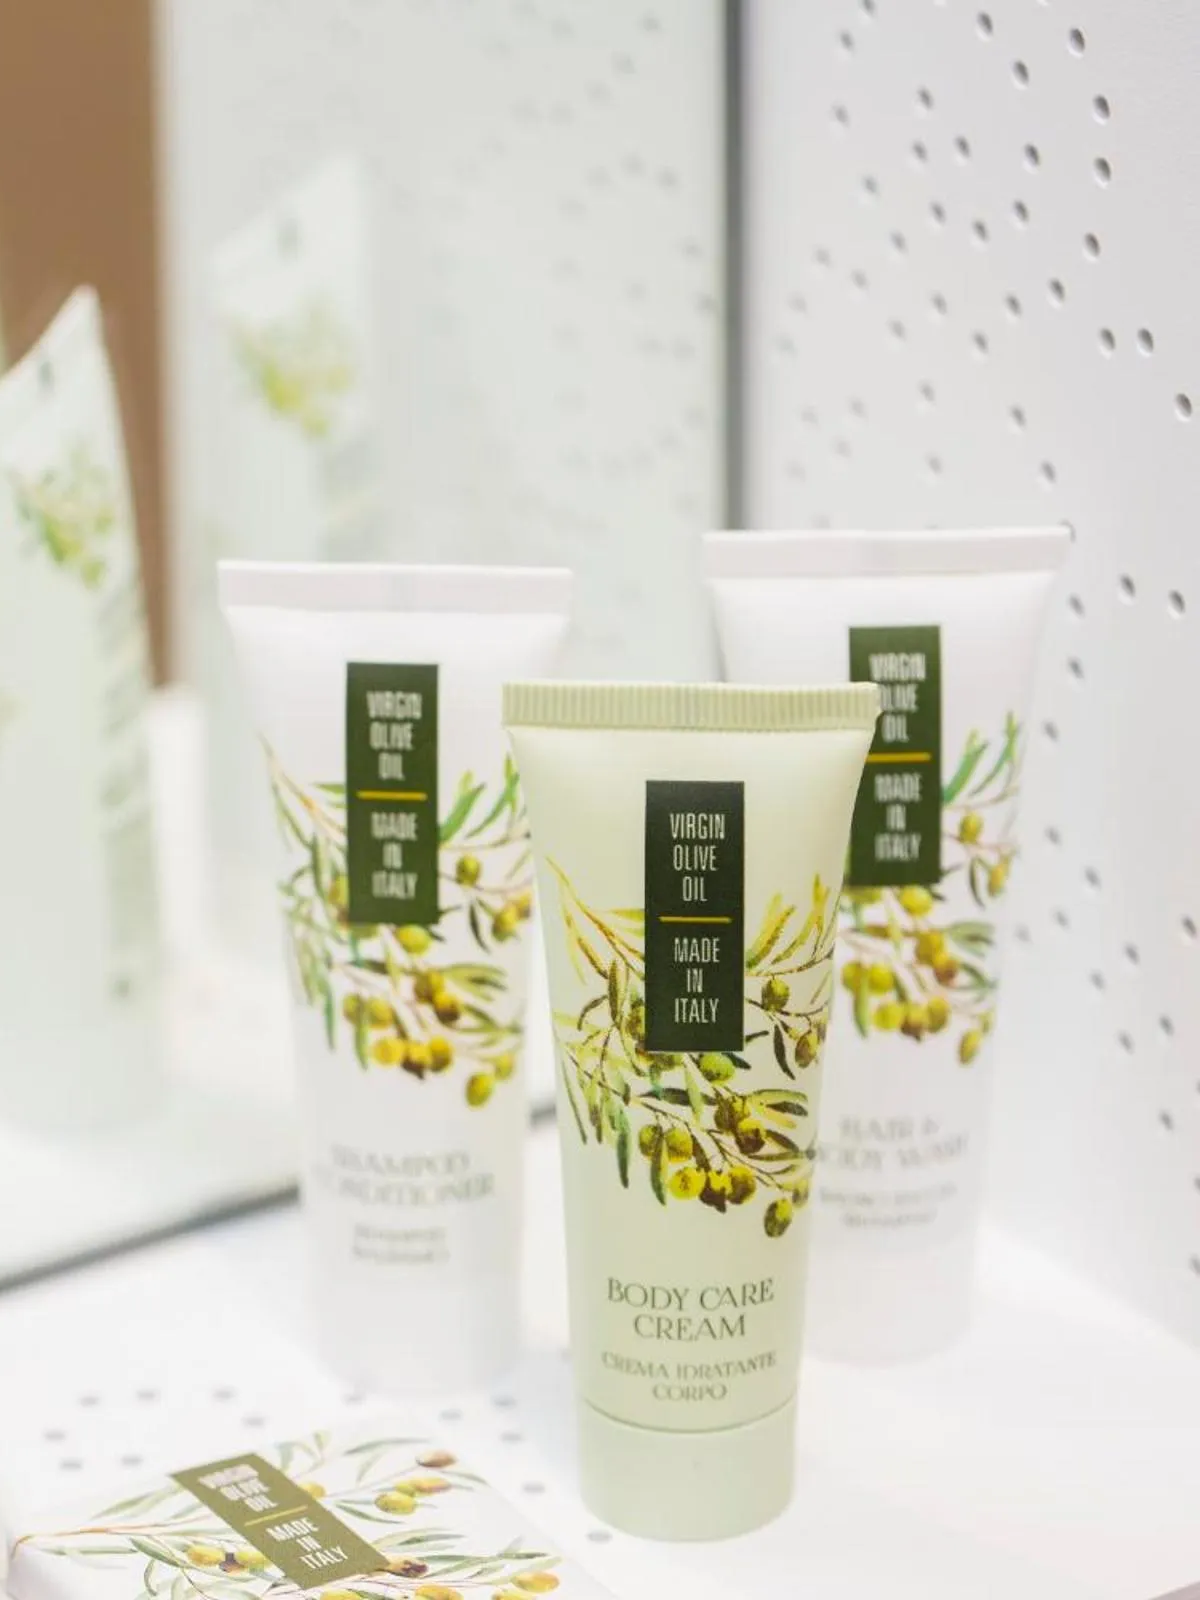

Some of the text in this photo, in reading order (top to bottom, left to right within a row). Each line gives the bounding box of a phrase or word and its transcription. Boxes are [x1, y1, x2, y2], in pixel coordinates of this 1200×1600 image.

[868, 653, 926, 681] VIRGIN
[366, 690, 423, 719] VIRGIN
[369, 721, 413, 750] OLIVE
[881, 713, 909, 742] OIL
[378, 752, 405, 780] OIL
[874, 772, 922, 803] MADE
[370, 812, 418, 841] MADE
[670, 813, 726, 840] VIRGIN
[886, 804, 906, 832] IN
[382, 841, 402, 869] IN
[673, 845, 717, 871] OLIVE
[874, 832, 922, 862] ITALY
[371, 870, 418, 899] ITALY
[682, 876, 707, 902] OIL
[674, 937, 720, 963] MADE
[686, 968, 703, 993] IN
[674, 998, 719, 1024] ITALY
[607, 1276, 774, 1312] BODY CARE
[633, 1313, 746, 1342] CREAM
[601, 1350, 777, 1381] CREMA IDRATANTE
[652, 1383, 728, 1402] CORPO
[265, 1517, 320, 1543] MADE
[296, 1534, 322, 1551] IN
[299, 1545, 349, 1569] ITALY
